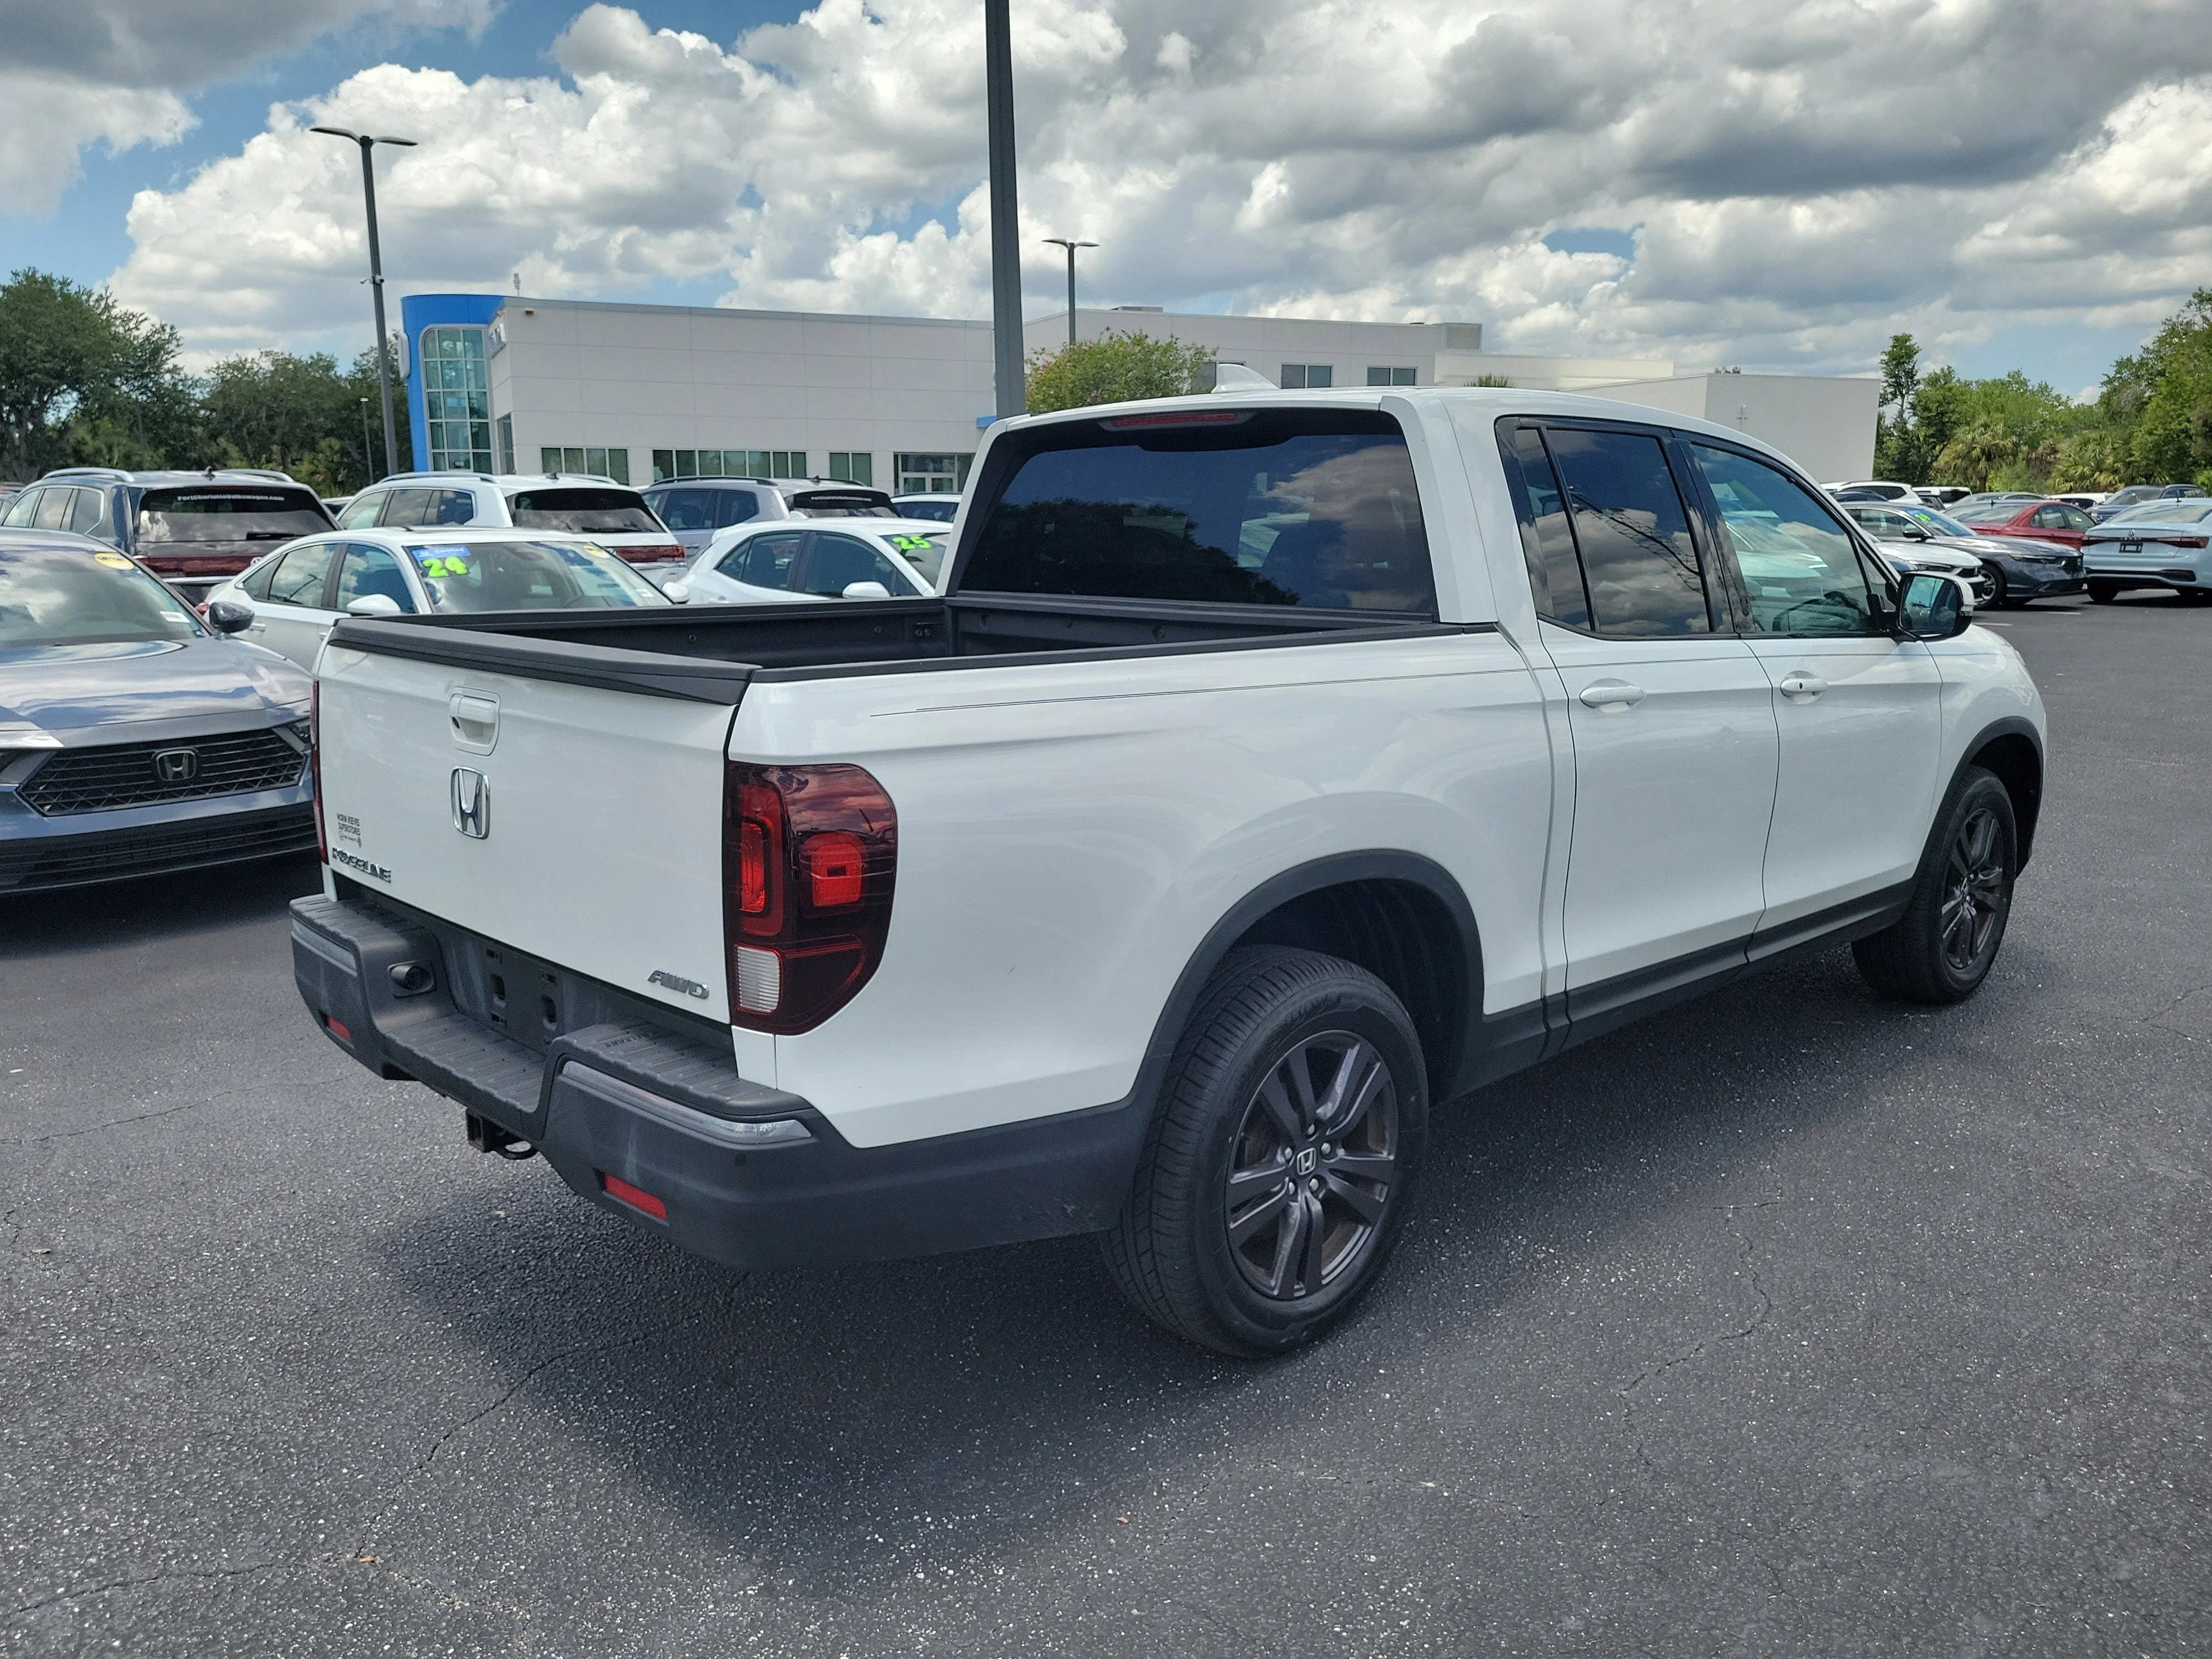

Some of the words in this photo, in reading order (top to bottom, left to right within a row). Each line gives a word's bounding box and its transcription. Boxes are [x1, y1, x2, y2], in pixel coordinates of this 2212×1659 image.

[891, 535, 932, 550] 25
[422, 556, 468, 577] 24
[647, 969, 709, 999] AWD
